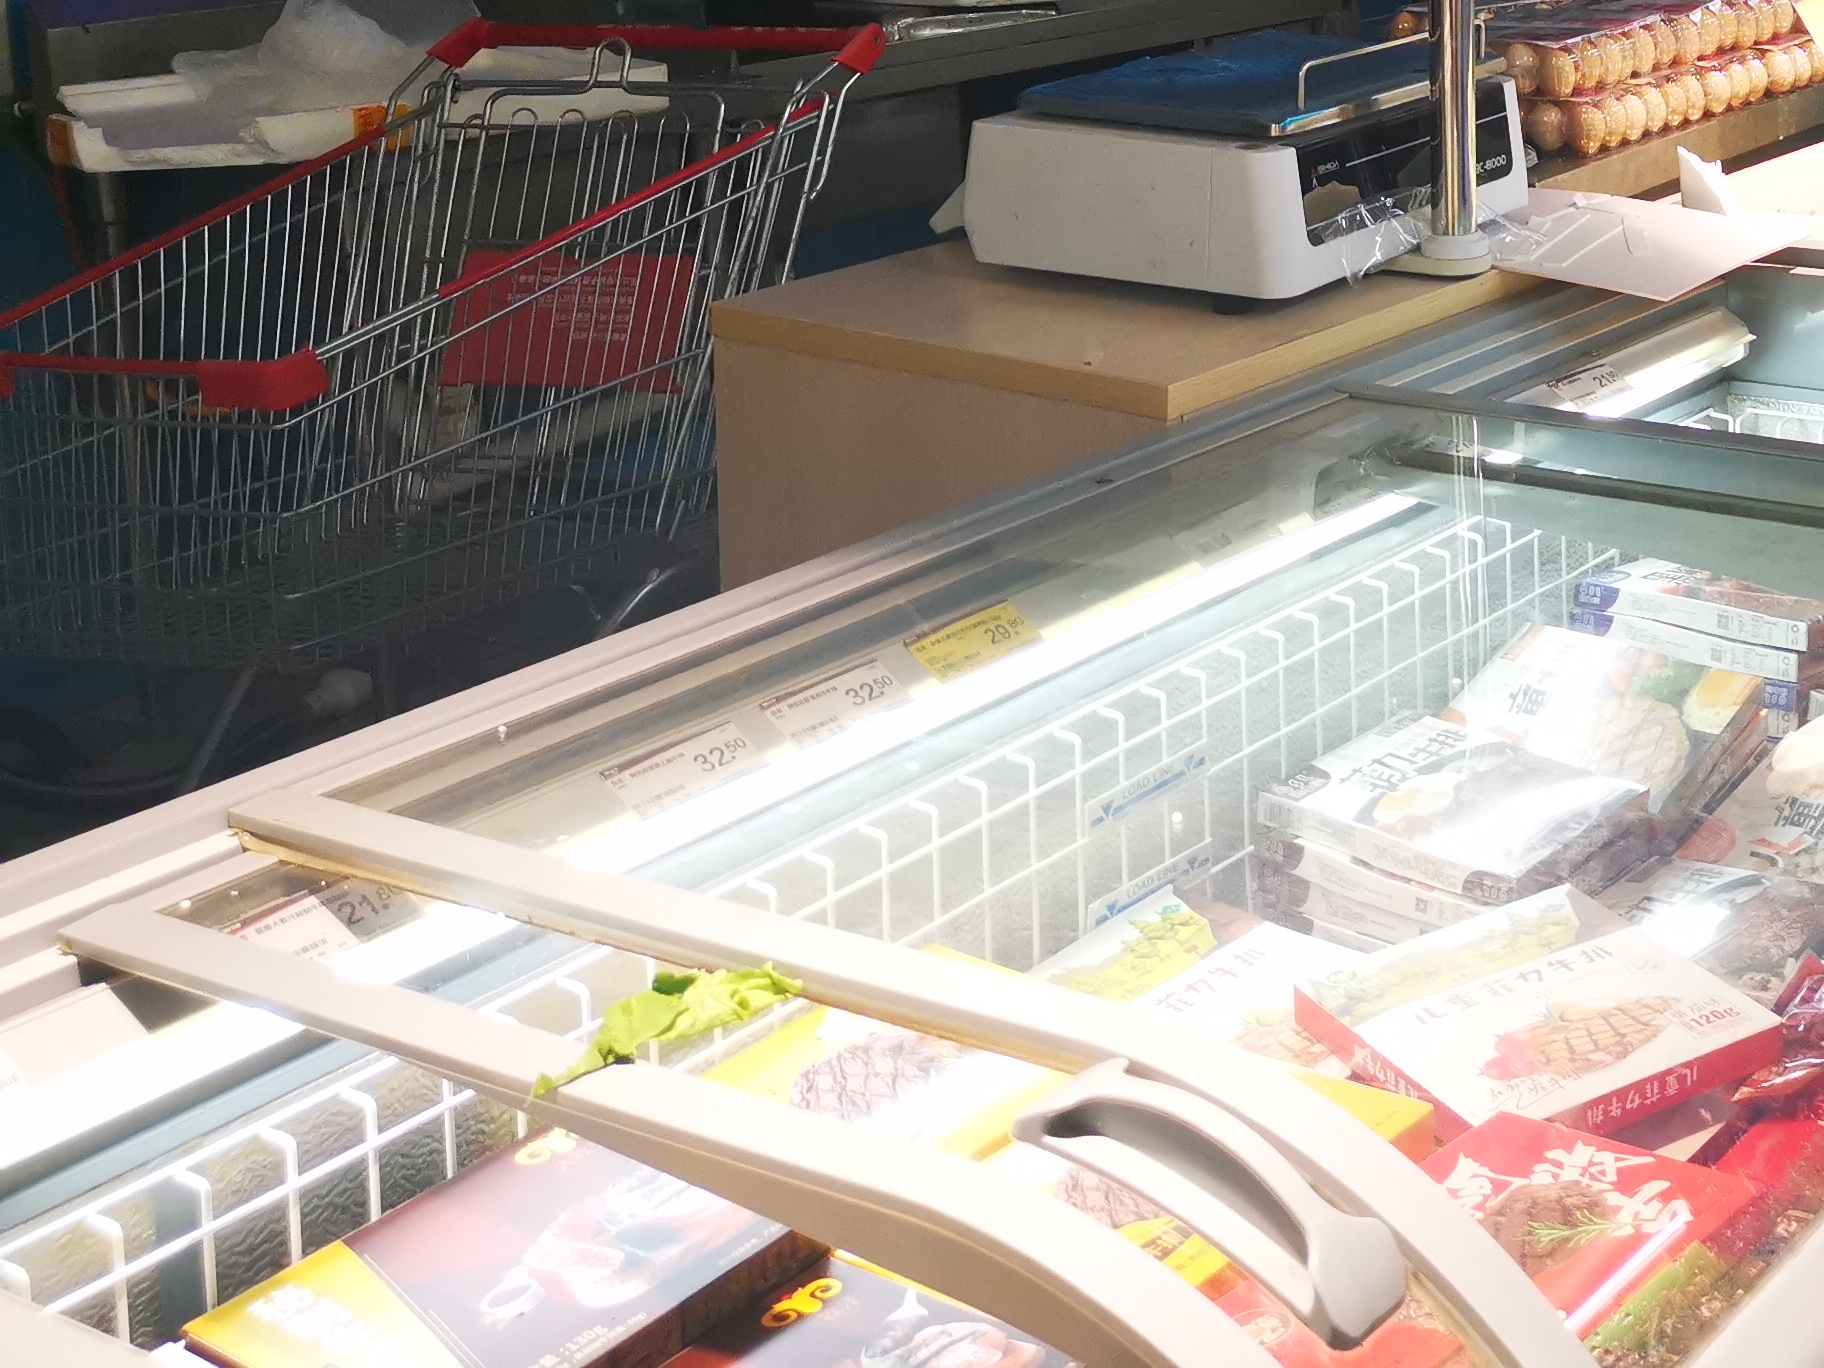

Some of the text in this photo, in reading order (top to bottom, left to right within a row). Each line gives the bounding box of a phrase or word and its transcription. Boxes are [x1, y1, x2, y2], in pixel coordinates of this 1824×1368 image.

[845, 674, 894, 706] 32.50
[693, 737, 747, 773] 32.50
[1414, 944, 1614, 1025] 儿童菲力牛排
[1690, 1006, 1741, 1028] 120g
[1586, 1063, 1699, 1128] 儿童菲力牛排
